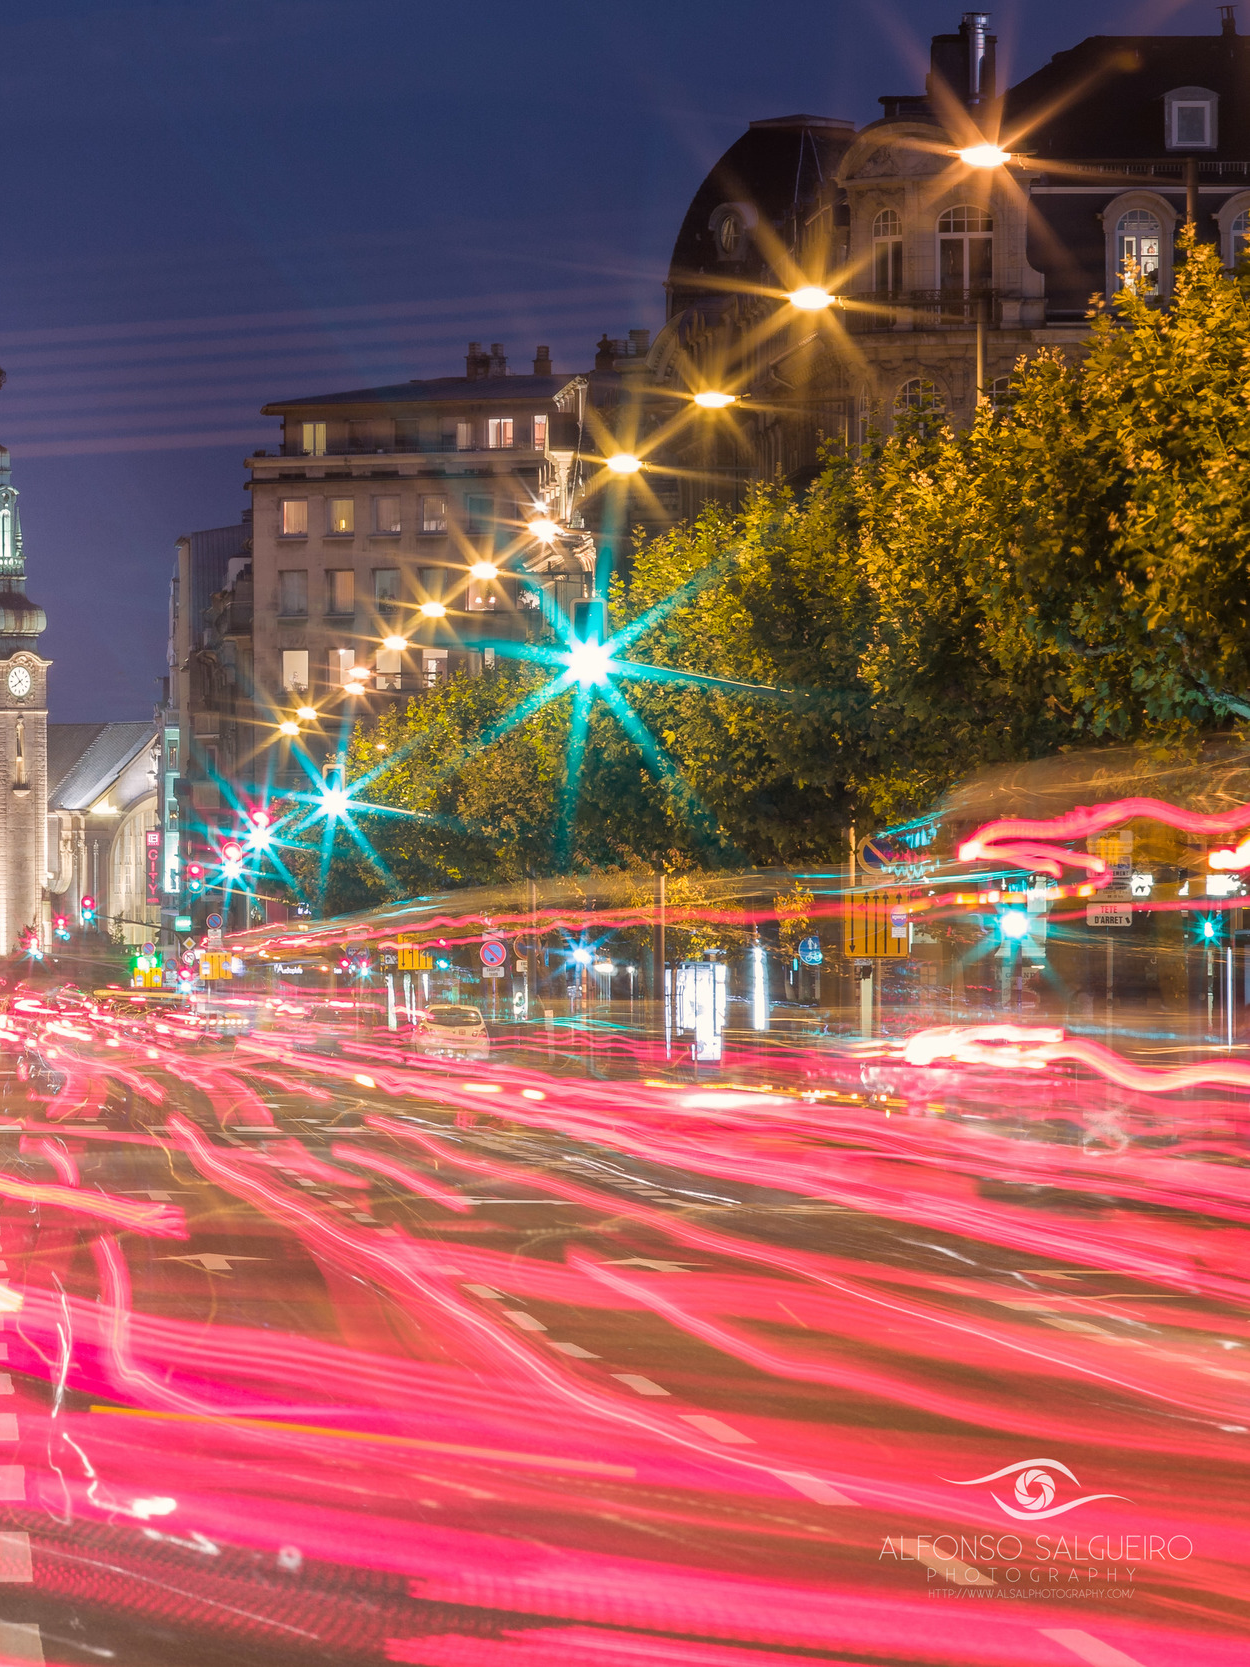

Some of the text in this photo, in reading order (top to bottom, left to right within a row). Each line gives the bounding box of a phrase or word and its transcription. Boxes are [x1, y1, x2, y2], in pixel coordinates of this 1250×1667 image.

[147, 849, 159, 895] CITY
[1100, 905, 1118, 914] TETE
[1094, 916, 1123, 925] D'ARRET
